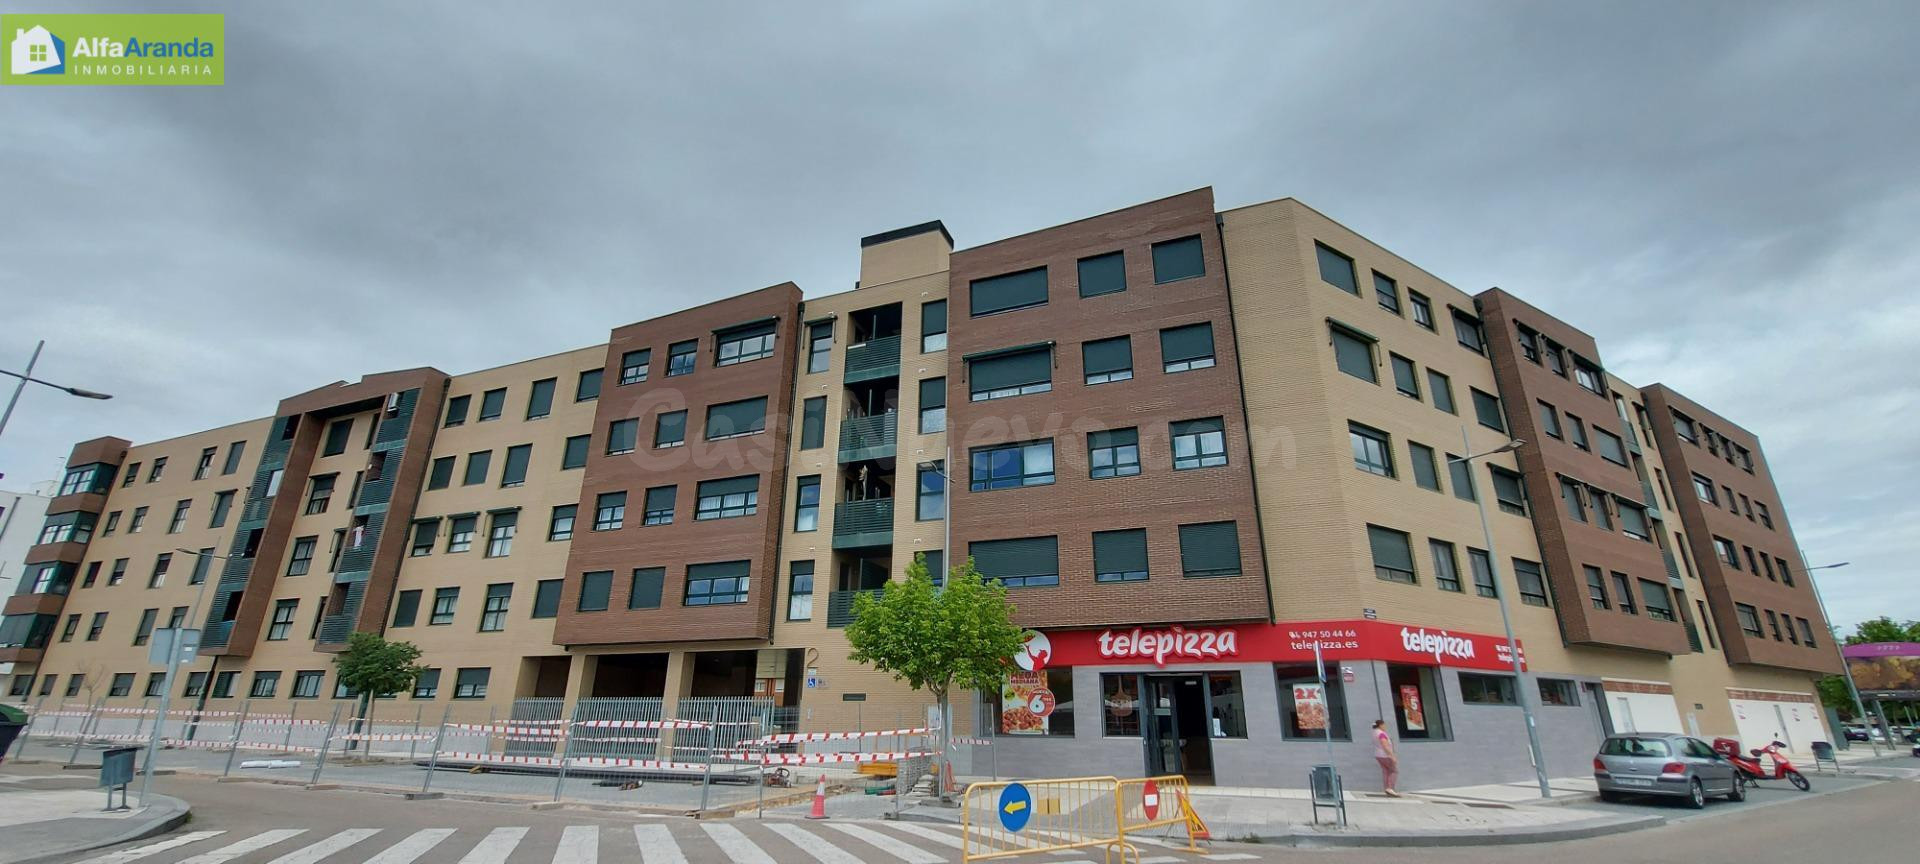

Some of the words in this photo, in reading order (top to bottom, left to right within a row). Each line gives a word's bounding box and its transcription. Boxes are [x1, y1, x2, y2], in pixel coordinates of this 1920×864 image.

[1345, 629, 1356, 637] 66
[1098, 626, 1236, 664] telepizza
[1401, 627, 1475, 663] telepizza
[807, 648, 819, 668] 2
[1029, 694, 1045, 714] 6
[1410, 696, 1418, 710] 5
